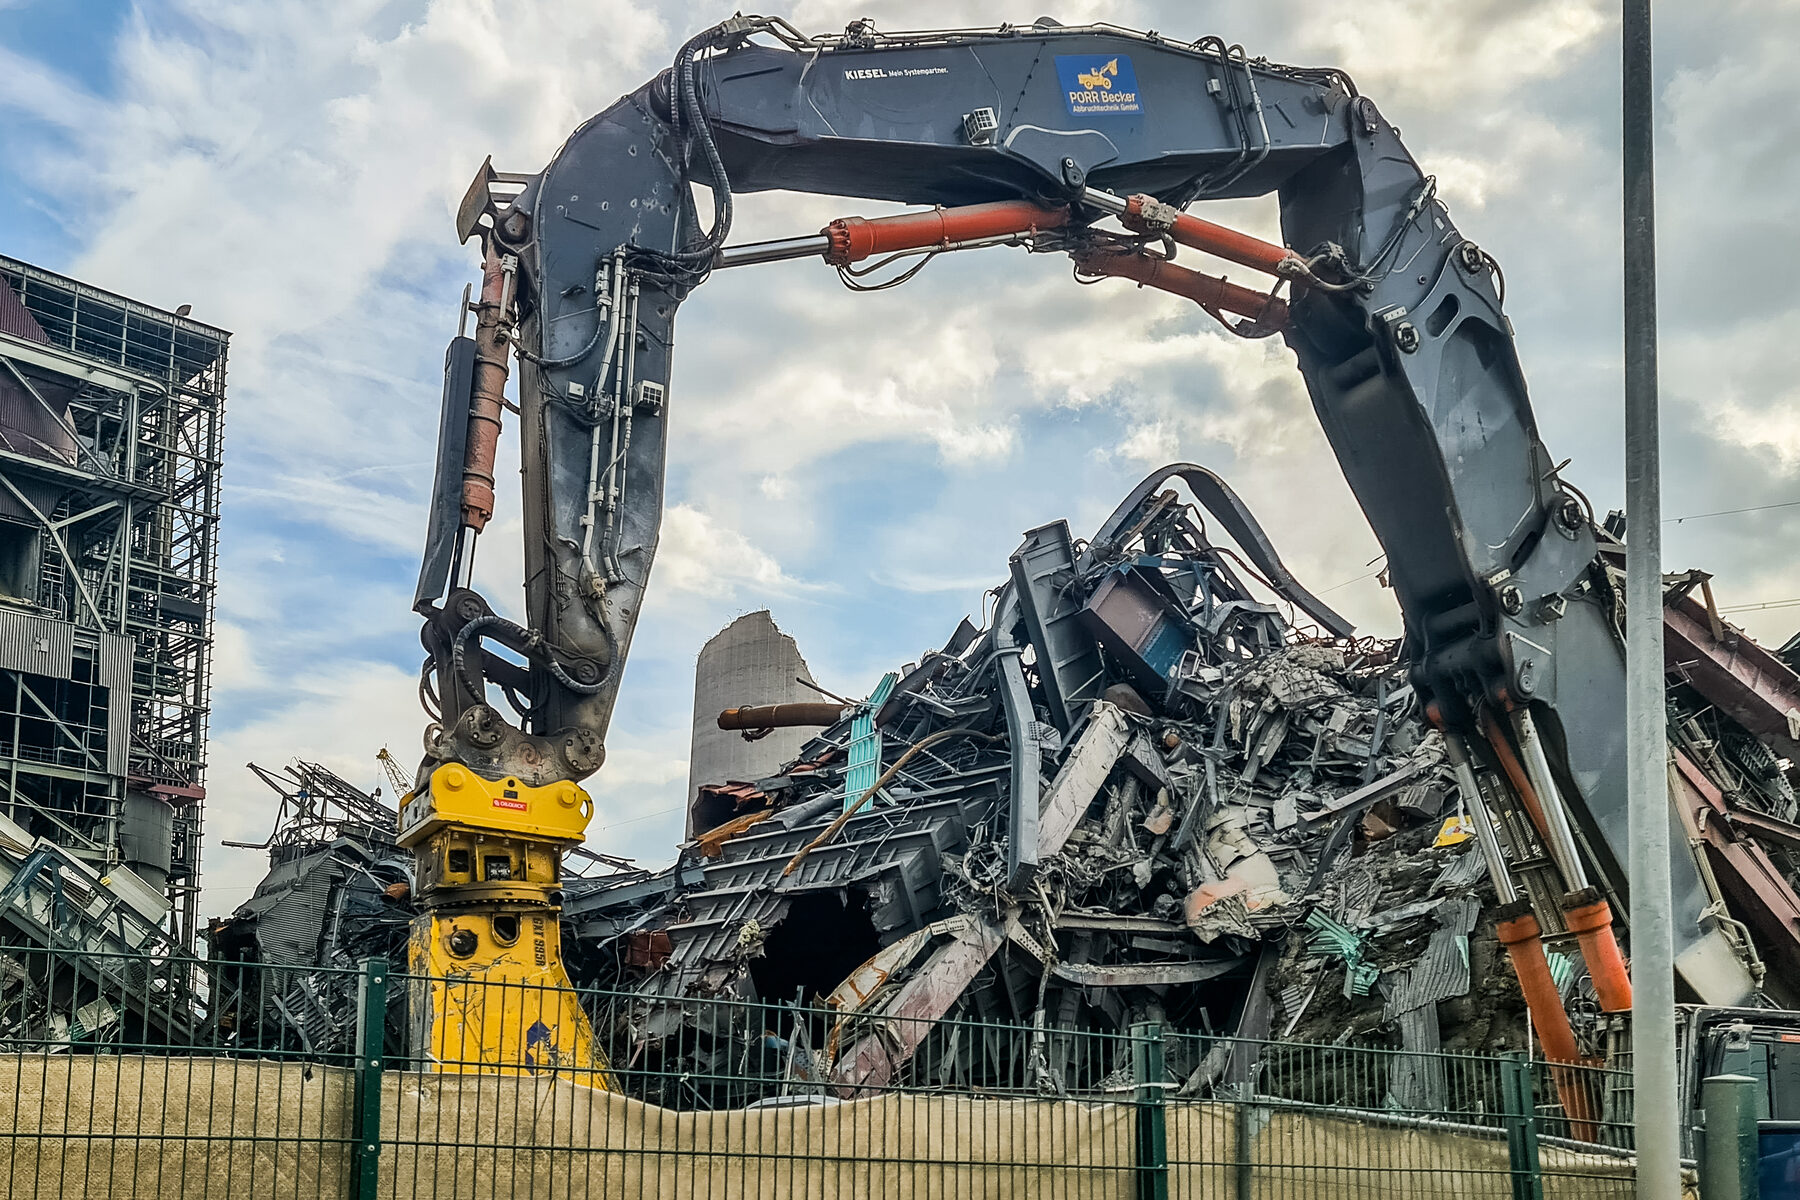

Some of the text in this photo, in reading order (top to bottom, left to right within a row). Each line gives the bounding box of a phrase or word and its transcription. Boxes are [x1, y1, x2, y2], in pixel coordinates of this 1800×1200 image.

[845, 69, 887, 80] KIESEL
[1069, 91, 1136, 104] PORR Becker
[1073, 103, 1140, 113] Abbruchtechnik GmbH
[534, 939, 546, 967] 995R
